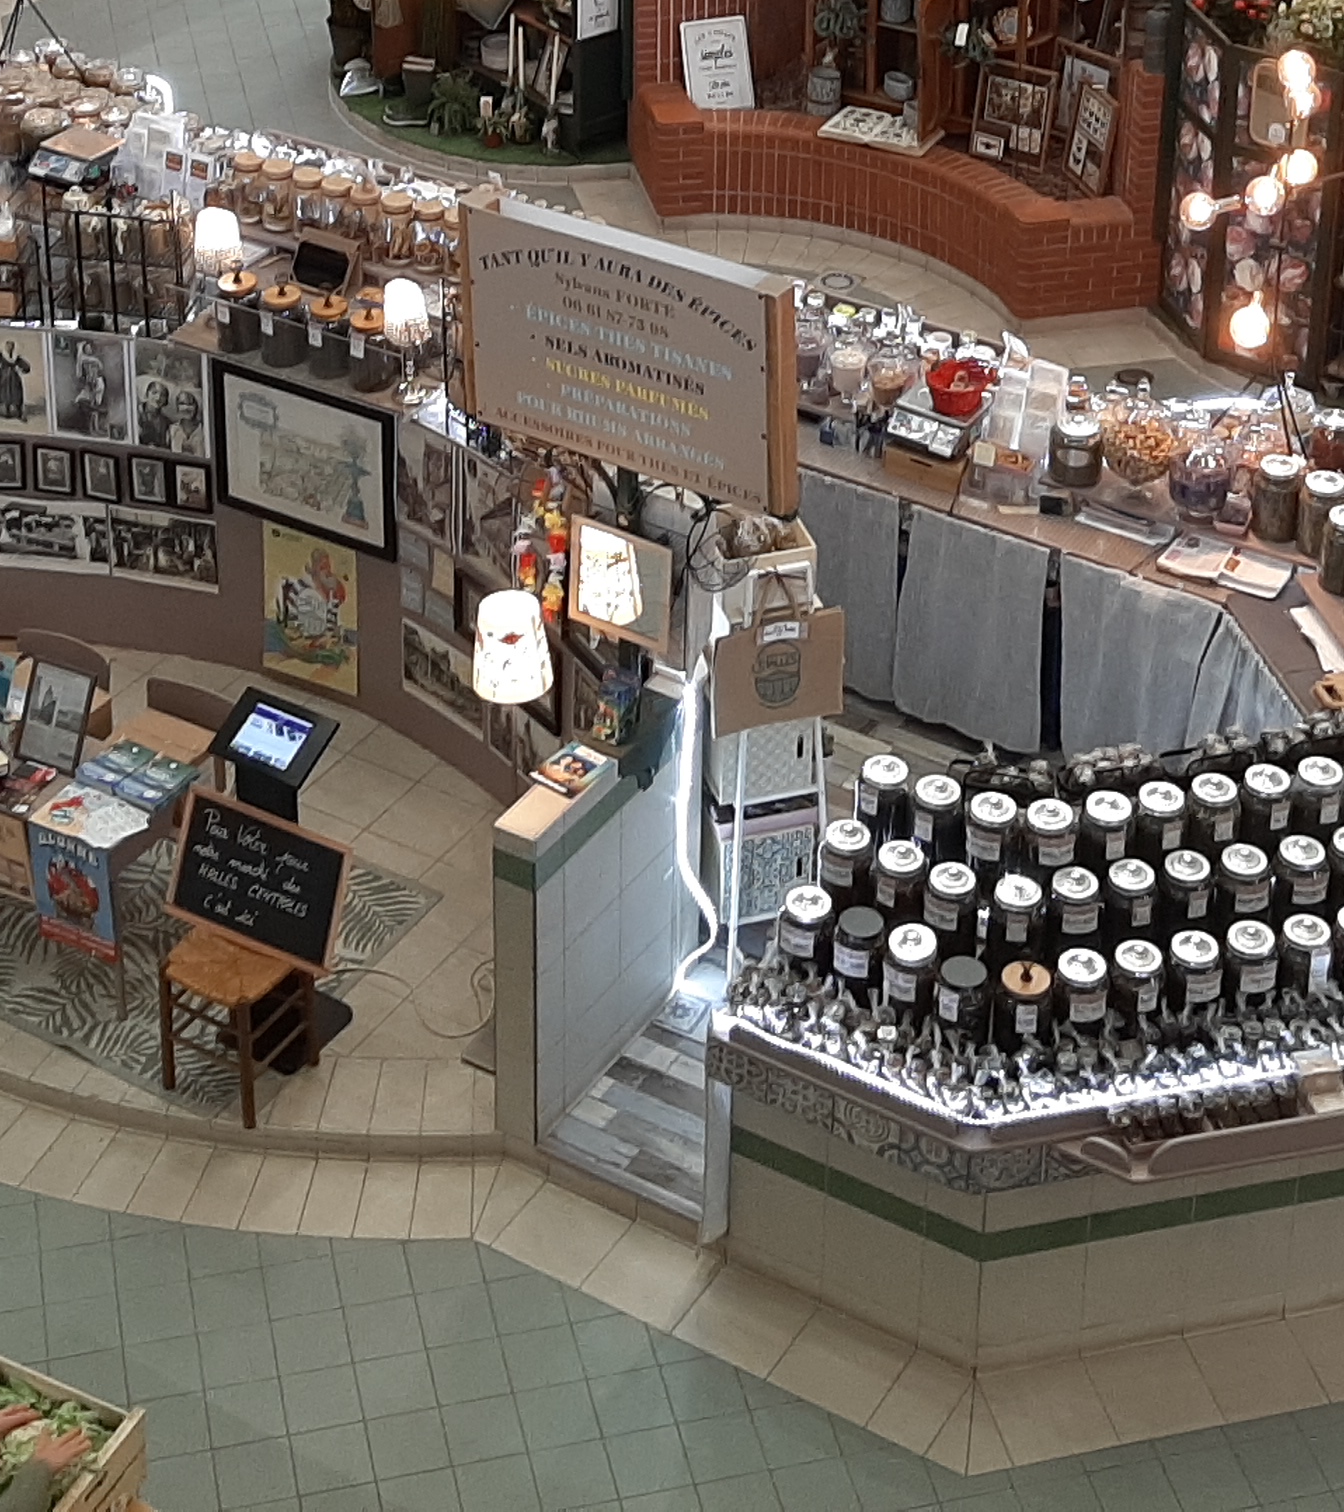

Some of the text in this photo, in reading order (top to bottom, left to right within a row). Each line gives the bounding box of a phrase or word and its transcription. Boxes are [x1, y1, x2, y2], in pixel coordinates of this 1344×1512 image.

[478, 247, 757, 352] TANT QU'IL Y AURA DES ÉPICES
[544, 335, 706, 396] SELS AROMATISÉS
[545, 356, 612, 390] SUCRES
[651, 342, 734, 382] TISANES
[515, 389, 563, 418] POUR
[596, 438, 636, 463] POUR
[682, 468, 703, 485] ET
[203, 807, 229, 840] Pour
[197, 862, 240, 891] HALLES
[235, 908, 261, 927] ici
